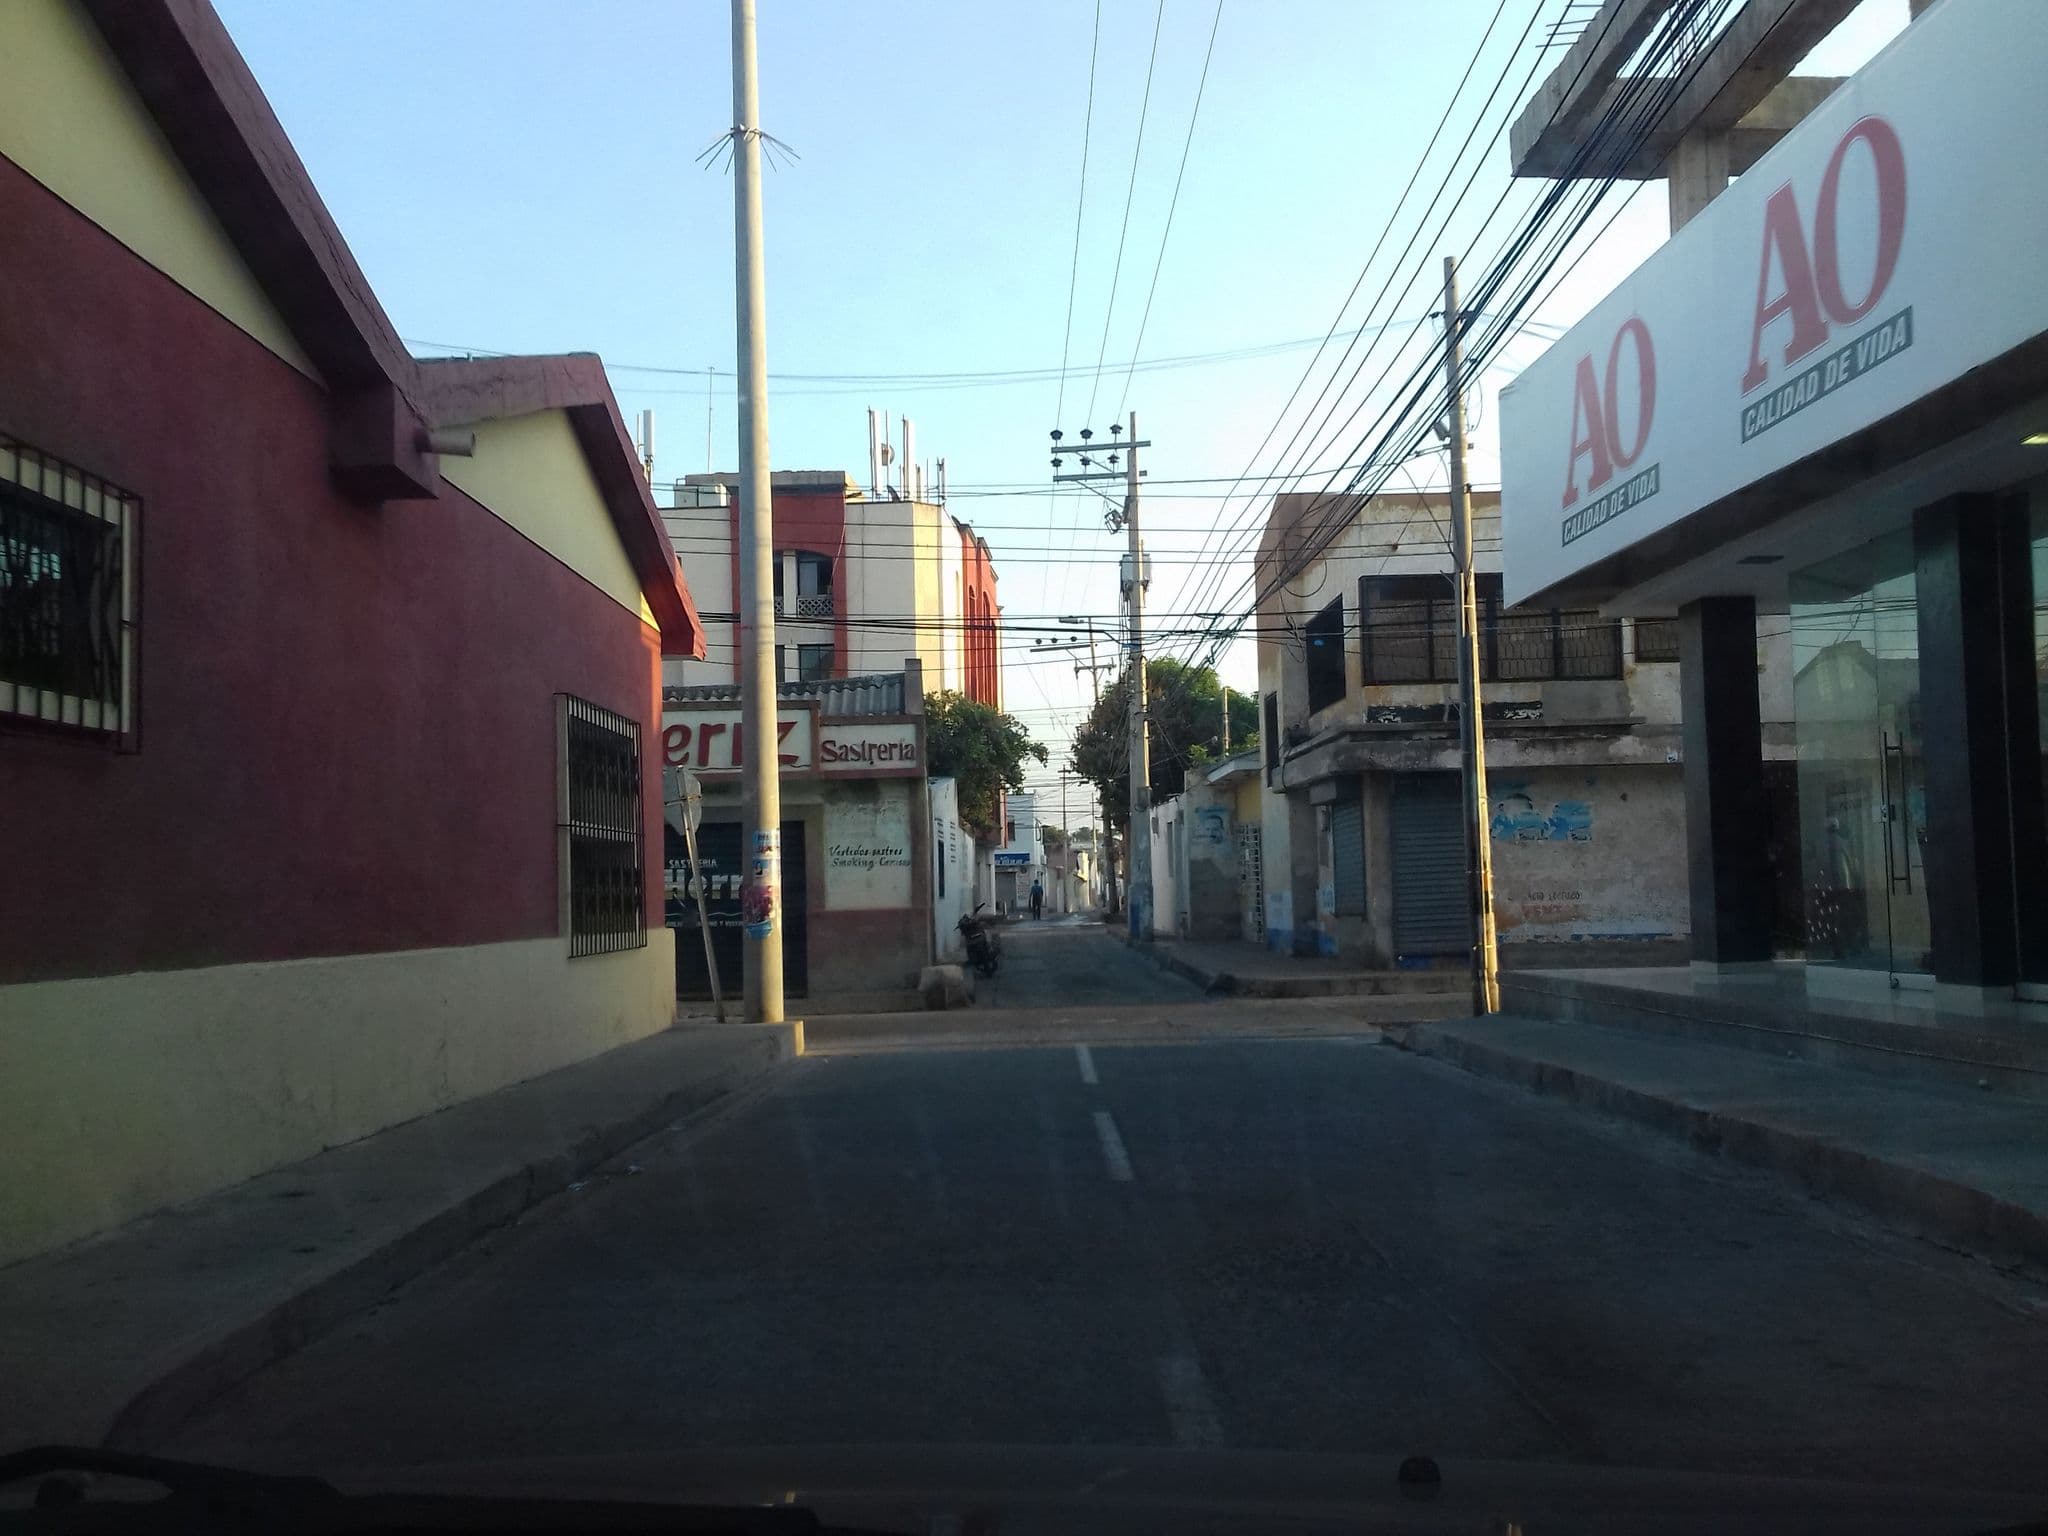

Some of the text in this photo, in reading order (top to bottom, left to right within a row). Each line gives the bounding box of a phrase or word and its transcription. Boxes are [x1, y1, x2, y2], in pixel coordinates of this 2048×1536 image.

[1741, 113, 1908, 397] AO
[1562, 316, 1657, 509] AO
[1744, 314, 1907, 438] CALIDAD DE VIDA
[1564, 469, 1657, 543] CALIDAD DE VIDA
[668, 858, 718, 870] SASTERIA
[832, 857, 875, 872] Smoking
